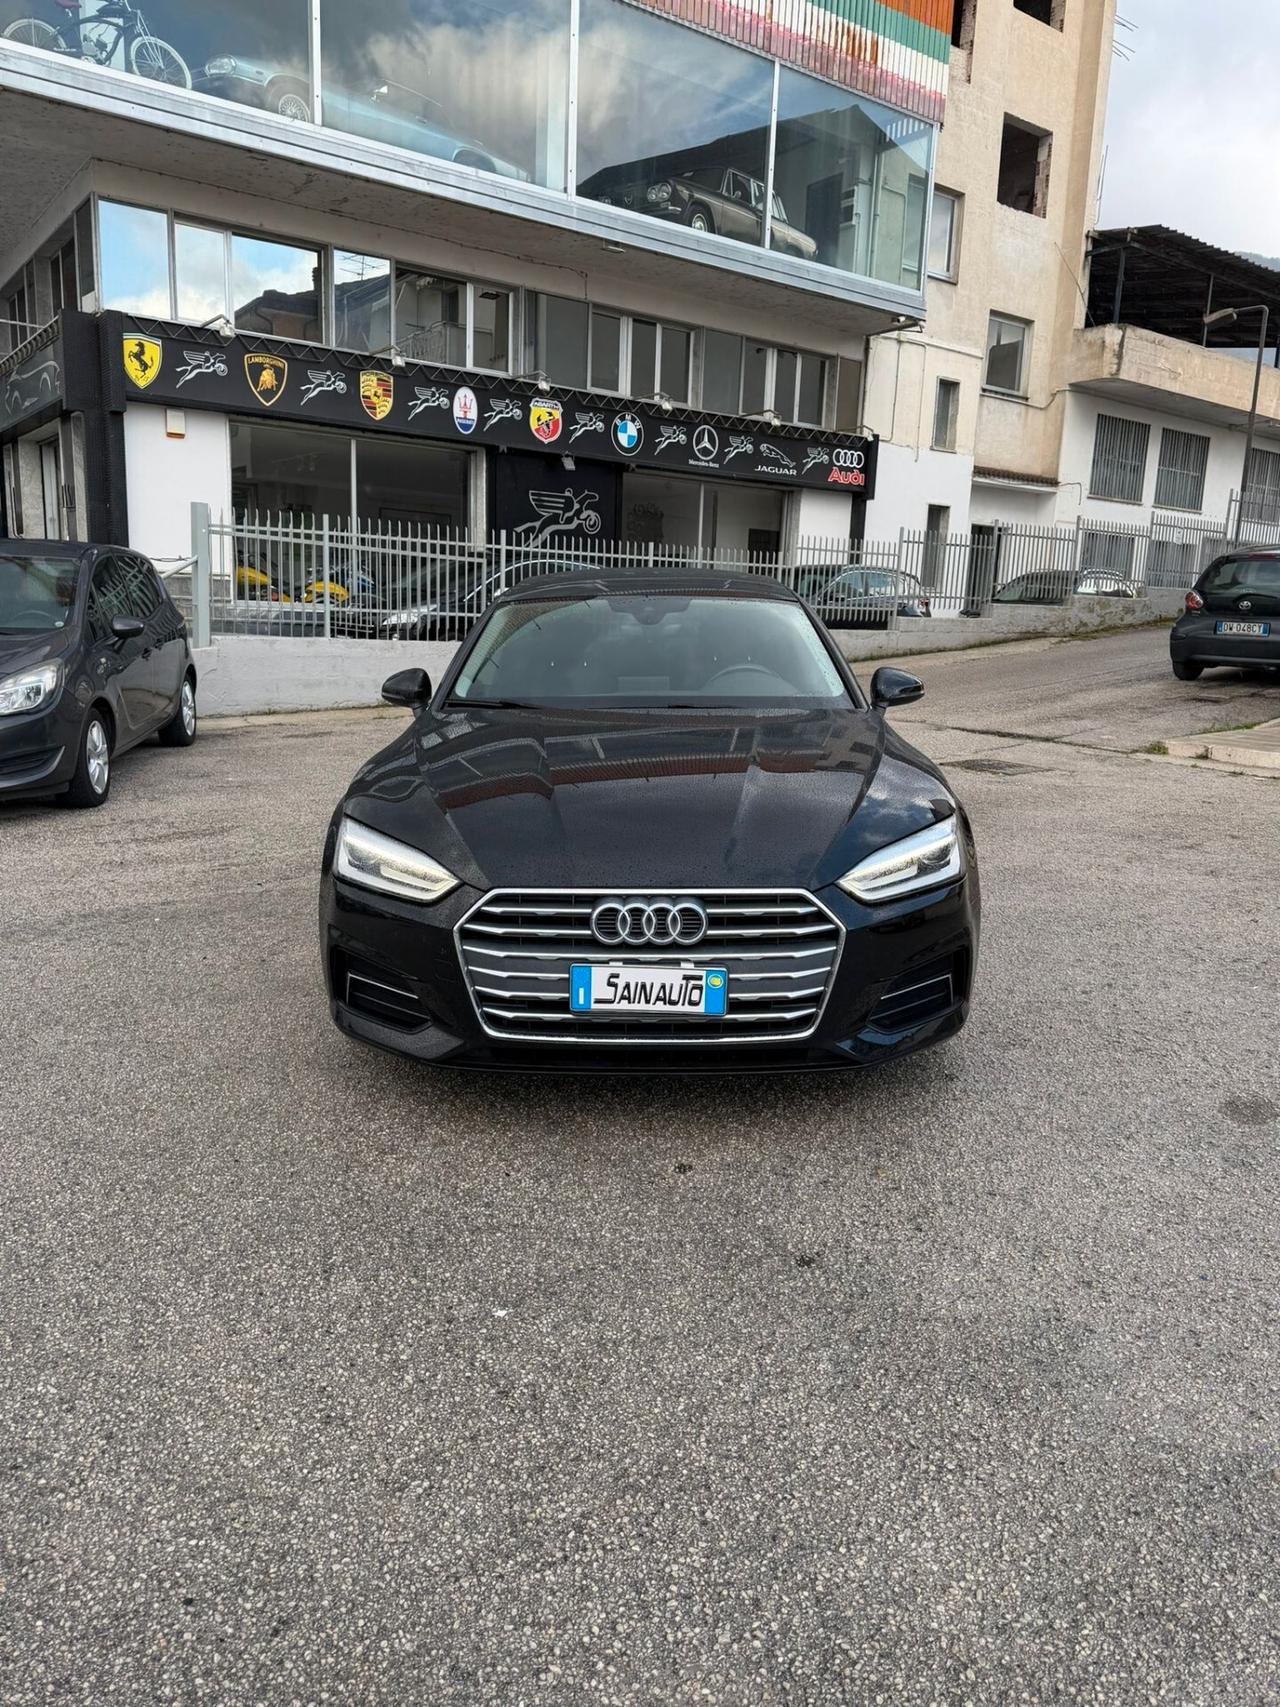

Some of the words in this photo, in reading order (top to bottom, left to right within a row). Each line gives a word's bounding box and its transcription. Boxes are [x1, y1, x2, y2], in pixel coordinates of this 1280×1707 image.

[615, 413, 641, 429] BMW
[754, 465, 798, 476] JAGUAR
[593, 972, 704, 1007] SAINAUTO
